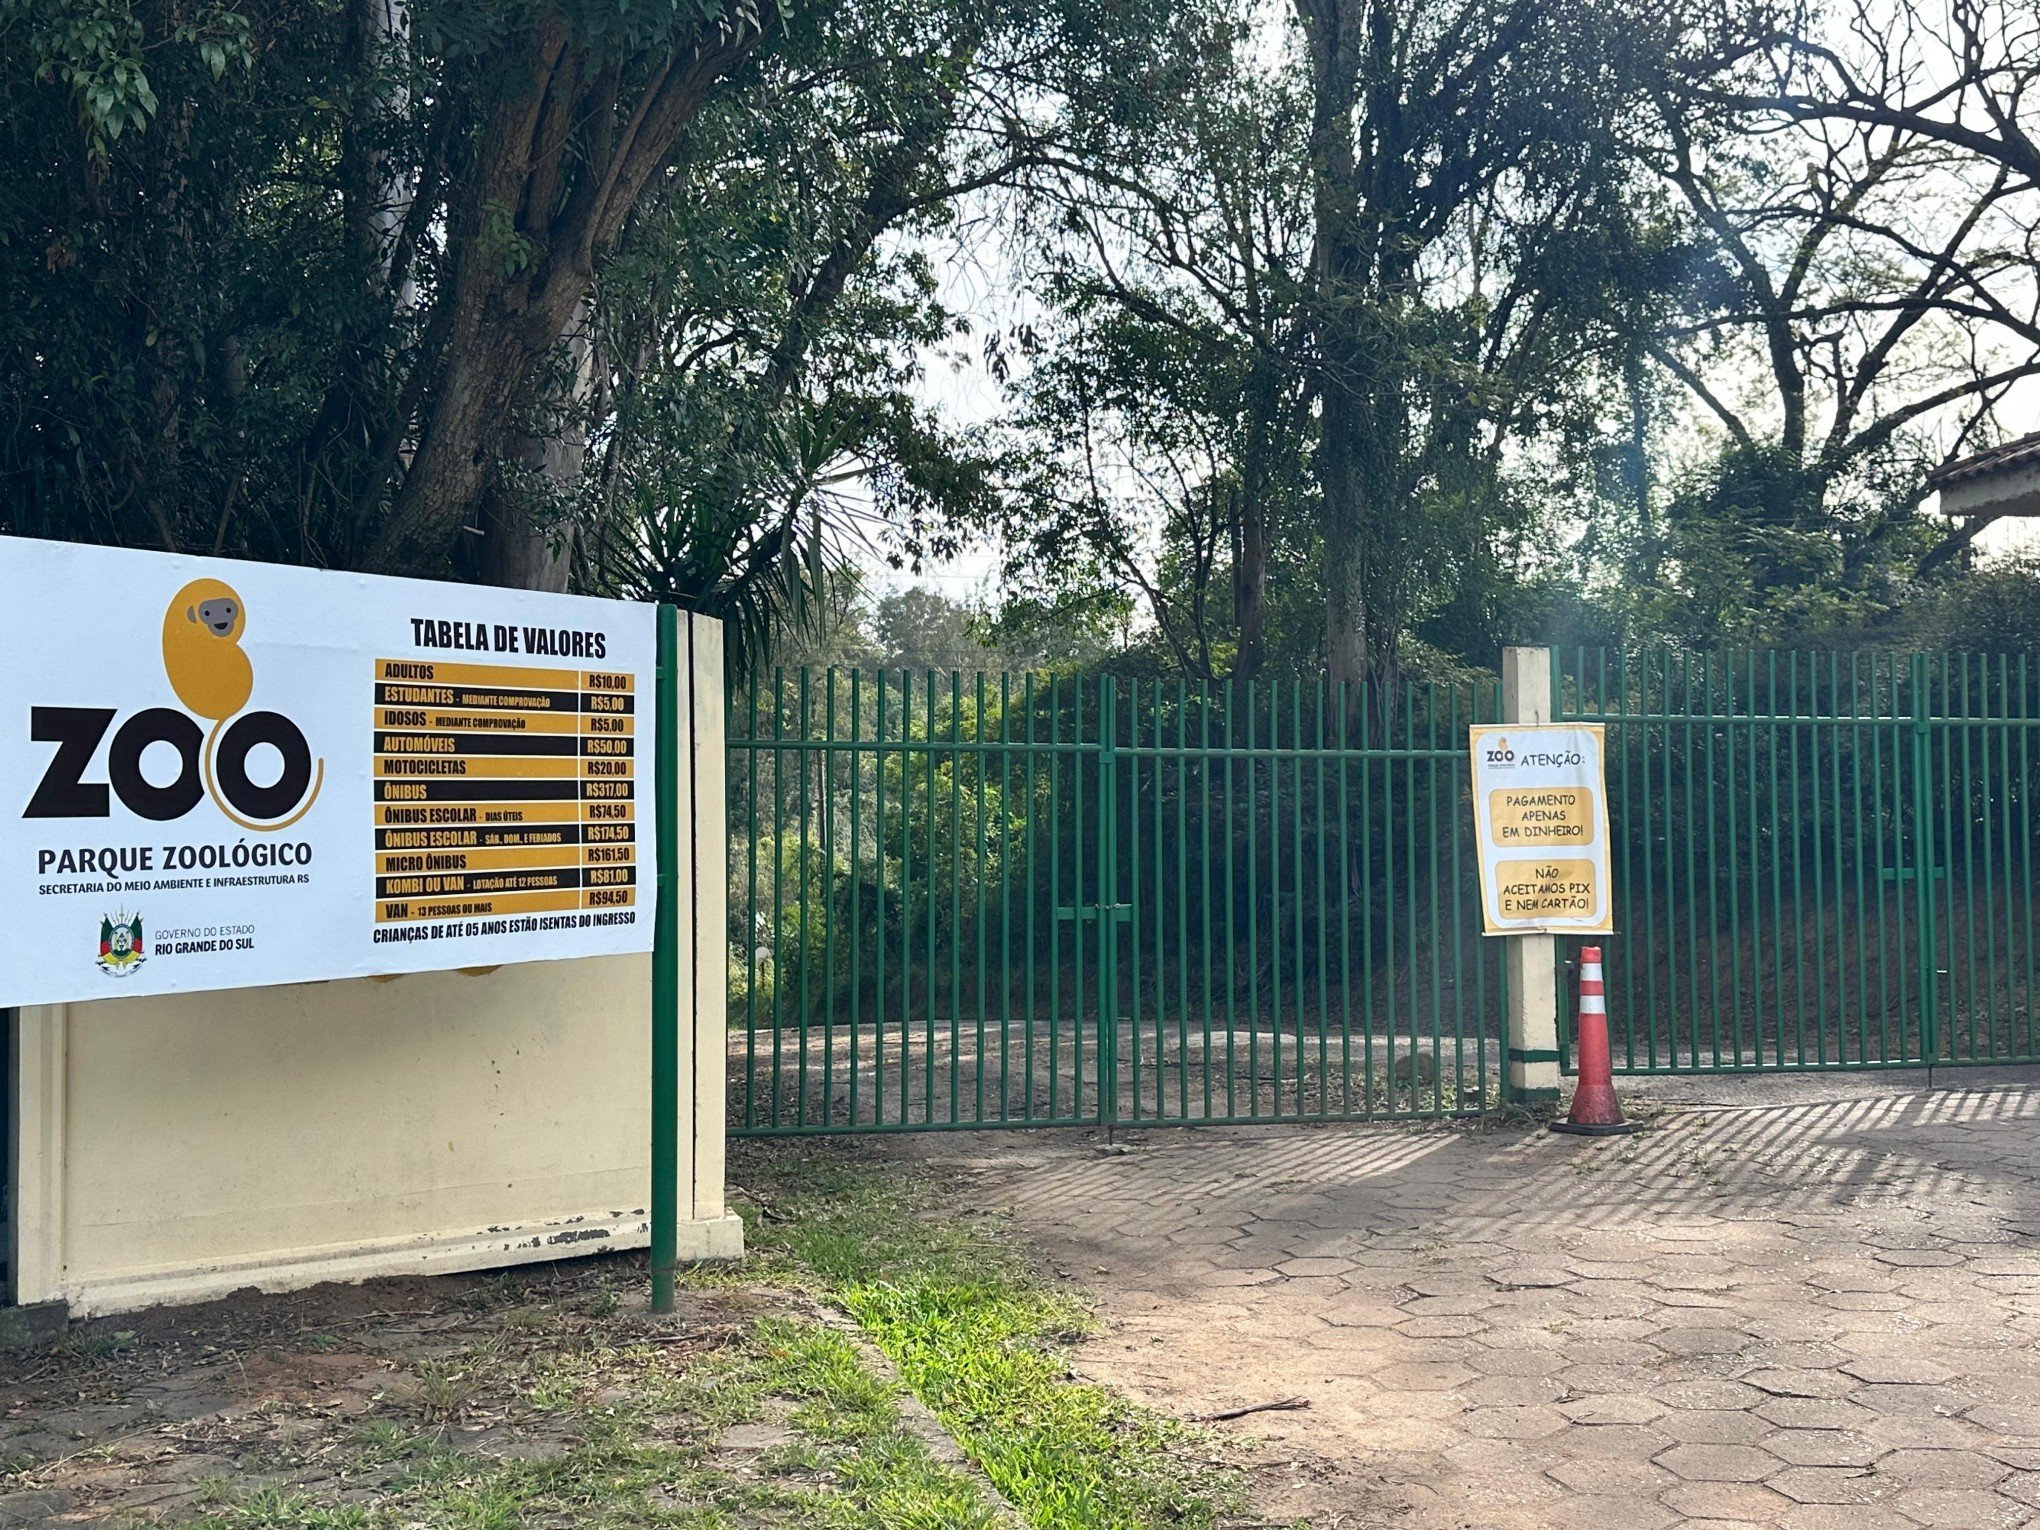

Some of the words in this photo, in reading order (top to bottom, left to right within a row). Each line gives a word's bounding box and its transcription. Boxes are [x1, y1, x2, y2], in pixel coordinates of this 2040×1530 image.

[411, 618, 489, 651] TABELA
[494, 625, 518, 653] DE
[523, 627, 606, 659] VALORES
[384, 663, 434, 679] ADULTOS
[589, 675, 626, 690] R$10,00
[384, 686, 454, 704] ESTUDANTES
[462, 694, 498, 706] MEDIANTE
[591, 697, 624, 711] R$5,00
[384, 711, 427, 726] IDOSOS
[436, 716, 471, 727] MEDIANTE
[590, 718, 624, 733] R$5,00
[383, 735, 455, 752] AUTOMÓVEIS
[587, 739, 627, 754] R$50,00
[21, 706, 311, 821] ZOO
[384, 759, 466, 774] MOTOCICLETAS
[588, 761, 626, 775] R$20,00
[1487, 750, 1514, 762] ZOO
[1521, 750, 1585, 768] ATENÇÃO:
[384, 785, 427, 800] ÔNIBUS
[586, 783, 628, 798] R$317,00
[1507, 795, 1575, 806] PAGAMENTO
[384, 806, 427, 823] ÔNIBUS
[430, 808, 476, 822] ESCOLAR
[485, 812, 502, 821] DIAS
[503, 810, 522, 821] ÚTEIS
[589, 805, 626, 819] R$74,50
[1522, 811, 1566, 821] APENAS
[385, 830, 427, 847] ÔNIBUS
[430, 831, 477, 845] ESCOLAR
[524, 834, 528, 843] E
[529, 833, 561, 843] FERIADOS
[588, 826, 629, 841] R$174,50
[1503, 827, 1519, 837] EM
[1525, 825, 1583, 836] DINHEIRO!
[39, 847, 153, 879] PARQUE
[163, 838, 312, 870] ZOOLÓGICO
[386, 856, 423, 872] MICRO
[426, 853, 466, 870] ÔNIBUS
[588, 847, 630, 862] R$161,50
[386, 878, 423, 894] KOMBI
[426, 877, 441, 892] OU
[443, 876, 464, 891] VAN
[473, 877, 503, 890] LOTAÇÃO
[505, 876, 517, 888] ATÉ
[518, 877, 526, 887] 12
[527, 876, 557, 886] PESSOAS
[590, 868, 628, 883] R$81,00
[1536, 866, 1559, 878] NÃO
[39, 883, 104, 895] SECRETARIA
[106, 882, 122, 892] DO
[124, 881, 150, 891] MEIO
[153, 879, 204, 890] AMBIENTE
[206, 878, 211, 888] E
[214, 875, 295, 888] INFRAESTRUTURA
[297, 874, 309, 884] RS
[1503, 883, 1565, 895] ACEITAMOS
[1570, 883, 1590, 893] PIX
[386, 903, 408, 919] VAN
[417, 906, 427, 917] 13
[428, 904, 461, 916] PESSOAS
[462, 903, 472, 914] OU
[474, 902, 492, 913] MAIS
[589, 890, 627, 905] R$94,50
[1505, 900, 1512, 910] E
[1517, 899, 1538, 910] NEM
[1541, 896, 1589, 909] CARTÃO!
[155, 928, 201, 940] GOVERNO
[203, 926, 217, 937] DO
[219, 924, 255, 936] ESTADO
[373, 924, 429, 944] CRIANÇAS
[431, 925, 443, 939] DE
[446, 920, 463, 938] ATÉ
[466, 922, 479, 936] 05
[481, 920, 507, 935] ANOS
[509, 916, 537, 933] ESTÃO
[540, 915, 576, 930] ISENTAS
[579, 913, 591, 927] DO
[593, 911, 635, 927] INGRESSO
[155, 943, 173, 955] RIO
[175, 941, 216, 954] GRANDE
[219, 940, 233, 951] DO
[235, 938, 254, 950] SUL
